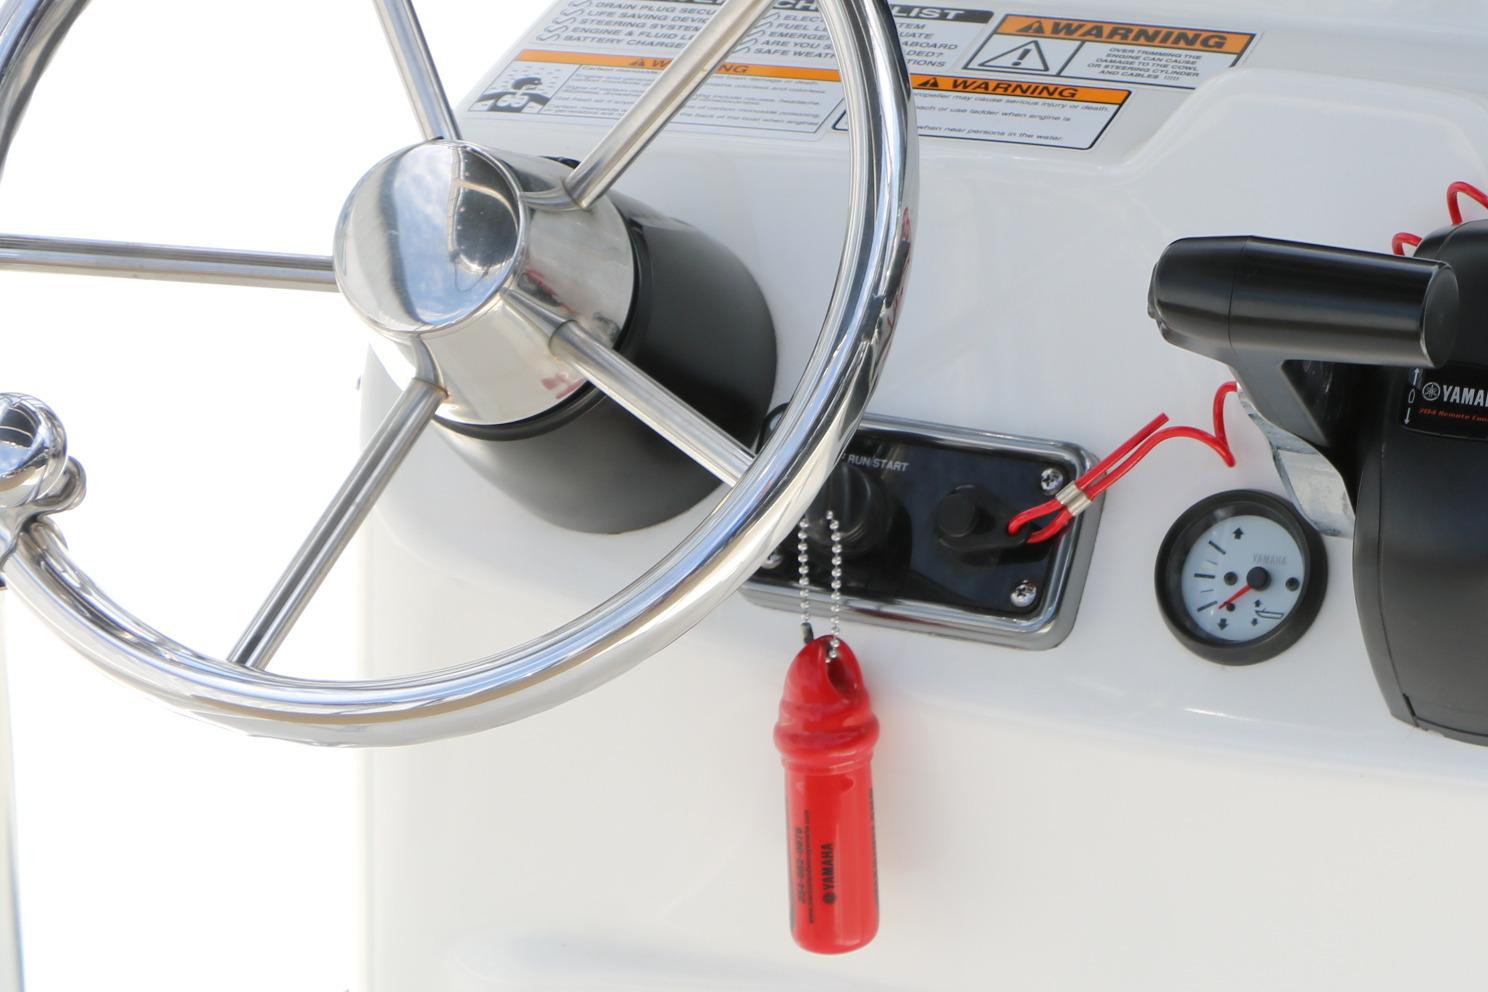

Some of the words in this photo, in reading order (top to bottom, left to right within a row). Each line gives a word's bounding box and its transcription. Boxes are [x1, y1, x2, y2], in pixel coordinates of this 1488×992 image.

[1050, 22, 1229, 49] WARNING
[951, 79, 1079, 99] WARNING
[847, 453, 870, 465] RUN
[872, 458, 909, 471] START
[821, 843, 835, 890] YAMAHA
